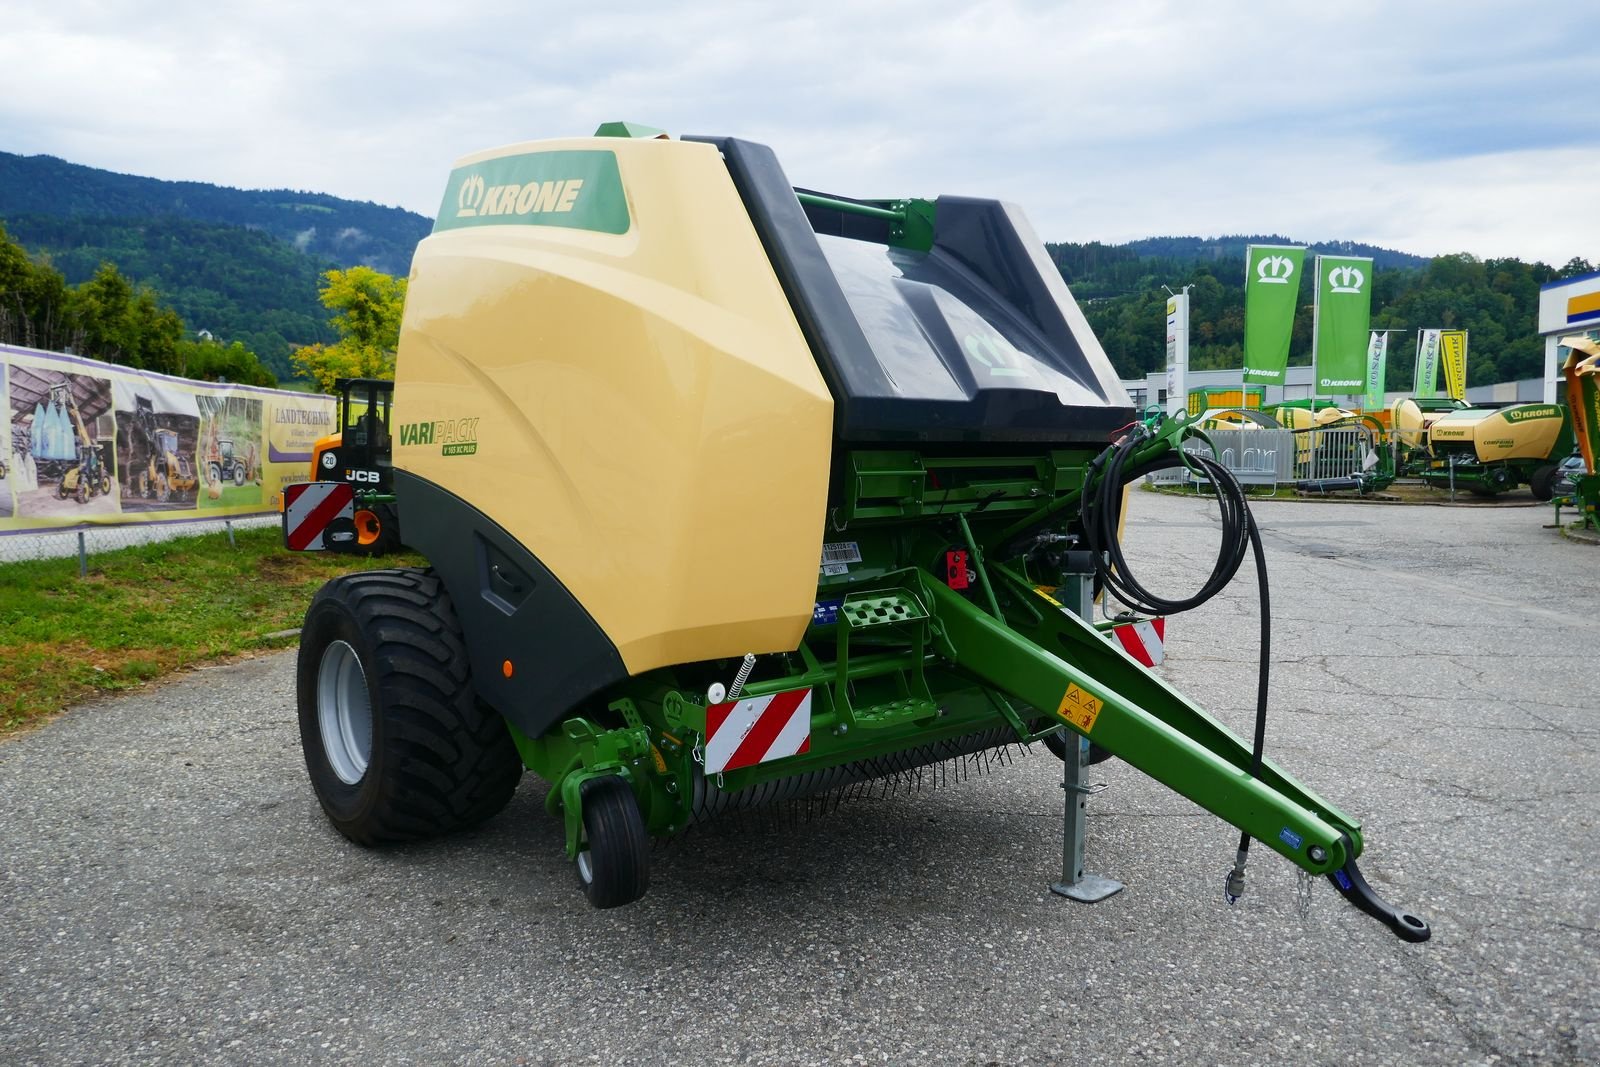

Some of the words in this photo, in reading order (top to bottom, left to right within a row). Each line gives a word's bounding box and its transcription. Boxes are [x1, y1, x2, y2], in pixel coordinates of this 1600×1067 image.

[479, 179, 584, 217] KRONE
[1249, 369, 1280, 377] KRONE
[275, 407, 331, 426] LANDTECHNIK
[1522, 408, 1555, 418] KRONE
[400, 417, 480, 447] VARIPACK
[463, 445, 476, 453] PLUS
[325, 456, 334, 466] 20
[346, 470, 380, 483] JCB
